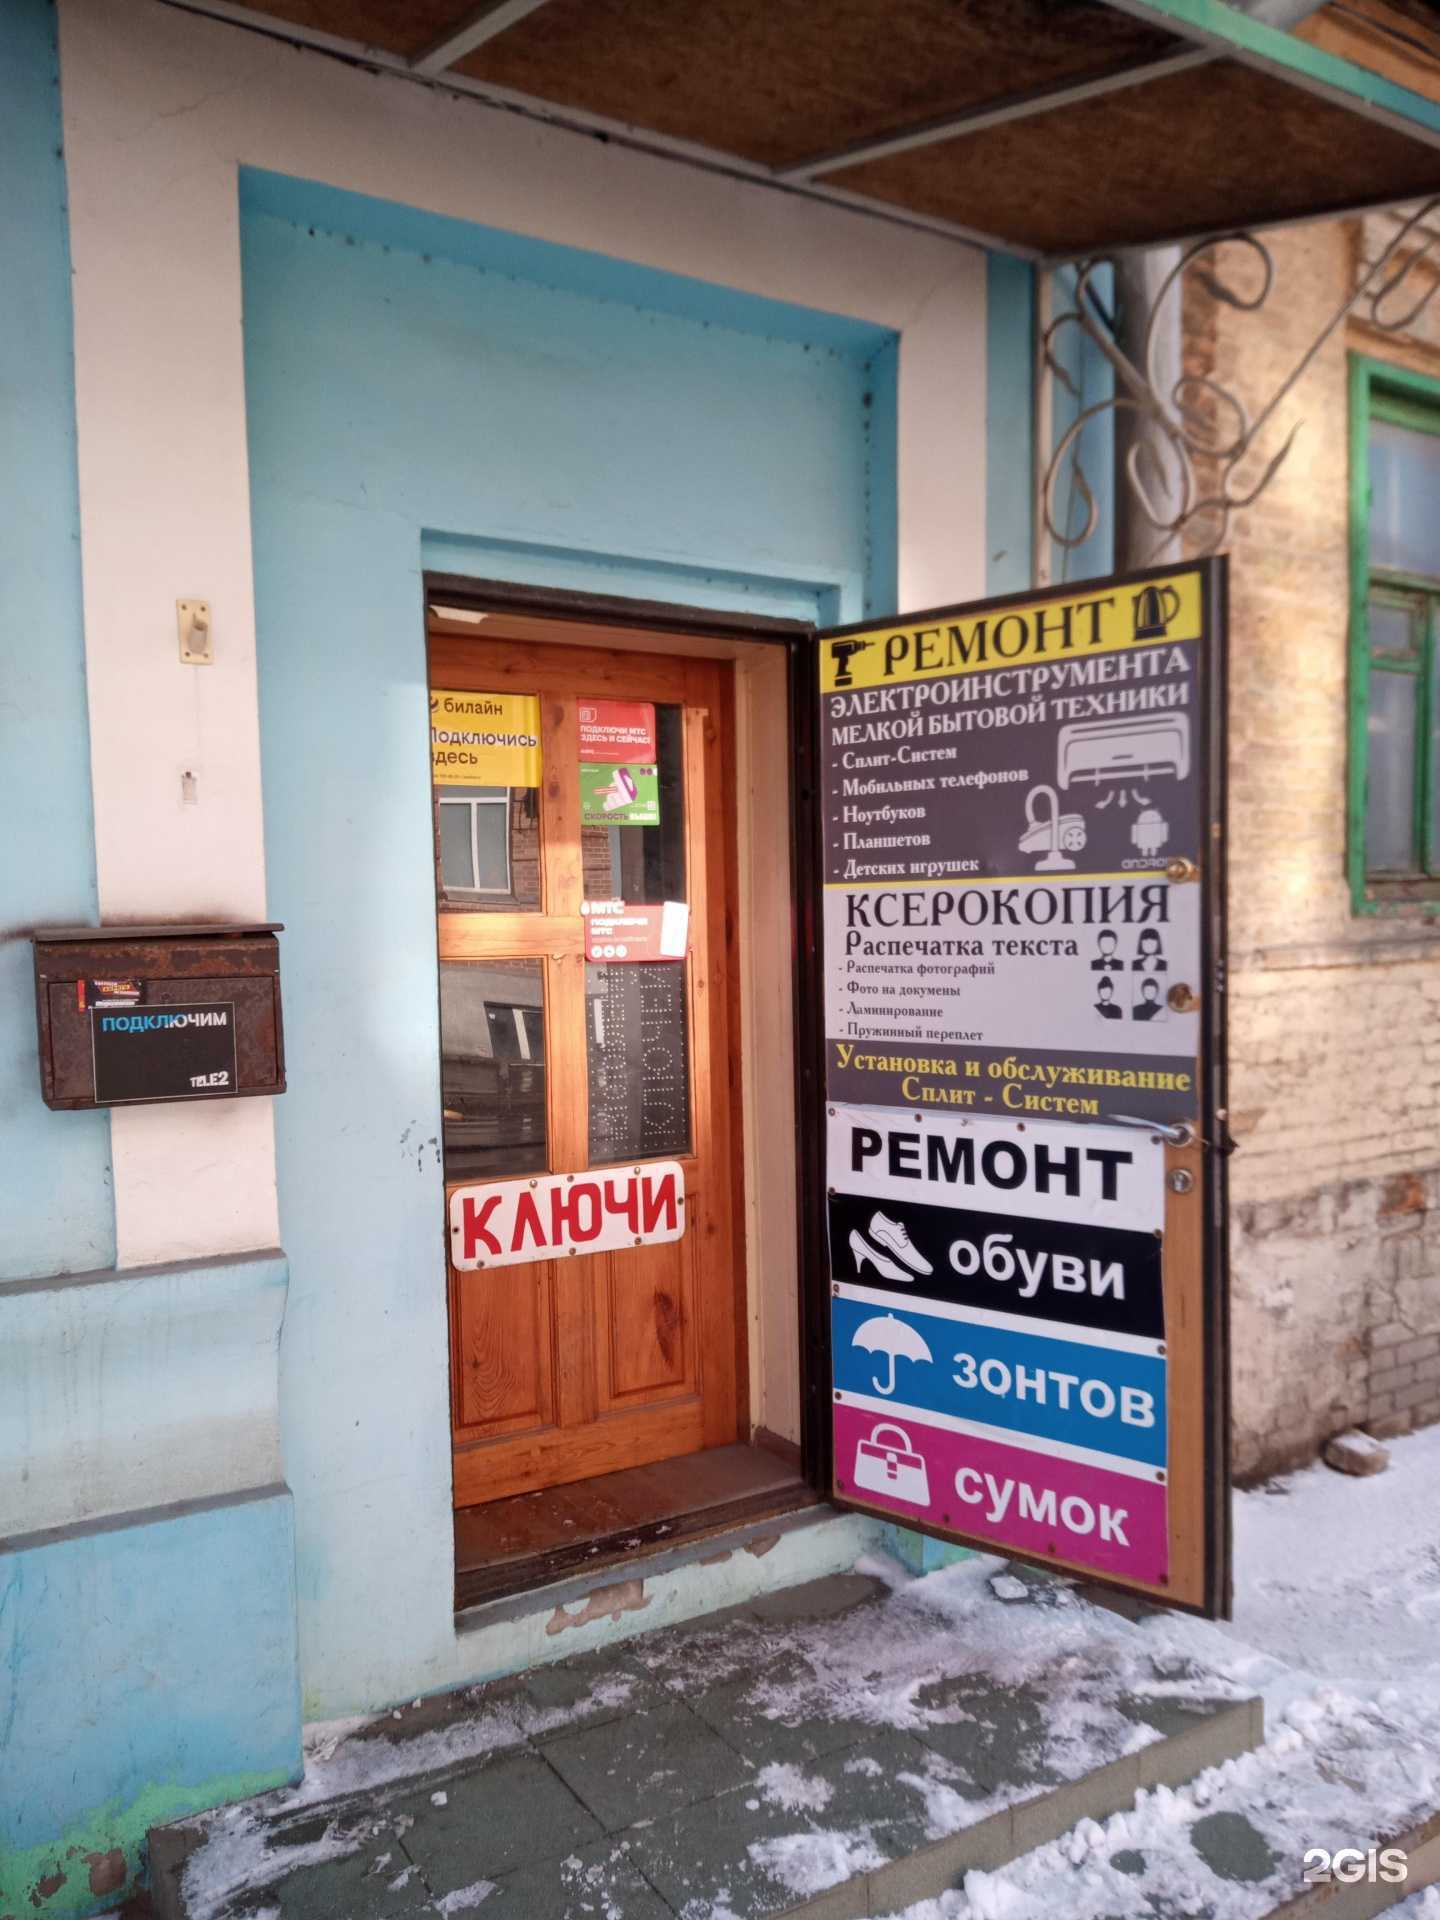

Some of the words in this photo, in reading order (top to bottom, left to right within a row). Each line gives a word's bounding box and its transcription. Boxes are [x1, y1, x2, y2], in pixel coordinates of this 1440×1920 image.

[883, 598, 1115, 677] РЕМОНТ
[830, 646, 1191, 719] ЭЛЕКТРОИНСТРУМЕНТА
[444, 697, 503, 715] билайн
[831, 711, 924, 747] МЕЛКОЙ
[928, 697, 1047, 735] БЫТОВОЙ
[1050, 682, 1190, 721] ТЕХНИКИ
[432, 751, 479, 766] десь
[842, 745, 958, 771] Сплит-Систем
[842, 775, 936, 797] Мобильных
[940, 768, 1029, 790] телефонов
[843, 804, 926, 827] Ноутбуков
[843, 831, 931, 851] Планшетов
[843, 859, 906, 879] Детских
[908, 857, 980, 877] игрушек
[845, 884, 1170, 928] КСЕРОКОПИЯ
[845, 930, 985, 958] Распечатка
[991, 937, 1079, 957] текста
[846, 959, 913, 975] Распечатка
[916, 961, 995, 978] фотографий
[846, 980, 879, 996] Фото
[881, 985, 896, 996] на
[898, 984, 961, 999] докумены
[101, 1011, 227, 1034] ПОДКЛЮЧИМ
[846, 1001, 943, 1020] Ламинирование
[847, 1022, 922, 1039] Пружинный
[926, 1028, 984, 1042] переплет
[190, 1070, 229, 1089] TELE2
[836, 1043, 958, 1077] Установка
[965, 1059, 981, 1076] и
[988, 1055, 1191, 1092] обслуживание
[902, 1076, 976, 1106] Сплит
[1002, 1083, 1099, 1116] Систем
[850, 1127, 1133, 1201] РЕМОНТ
[462, 1174, 677, 1259] КЛЮЧИ
[949, 1234, 1125, 1300] обуви
[952, 1352, 1156, 1428] зонтов
[954, 1467, 1130, 1547] сумок
